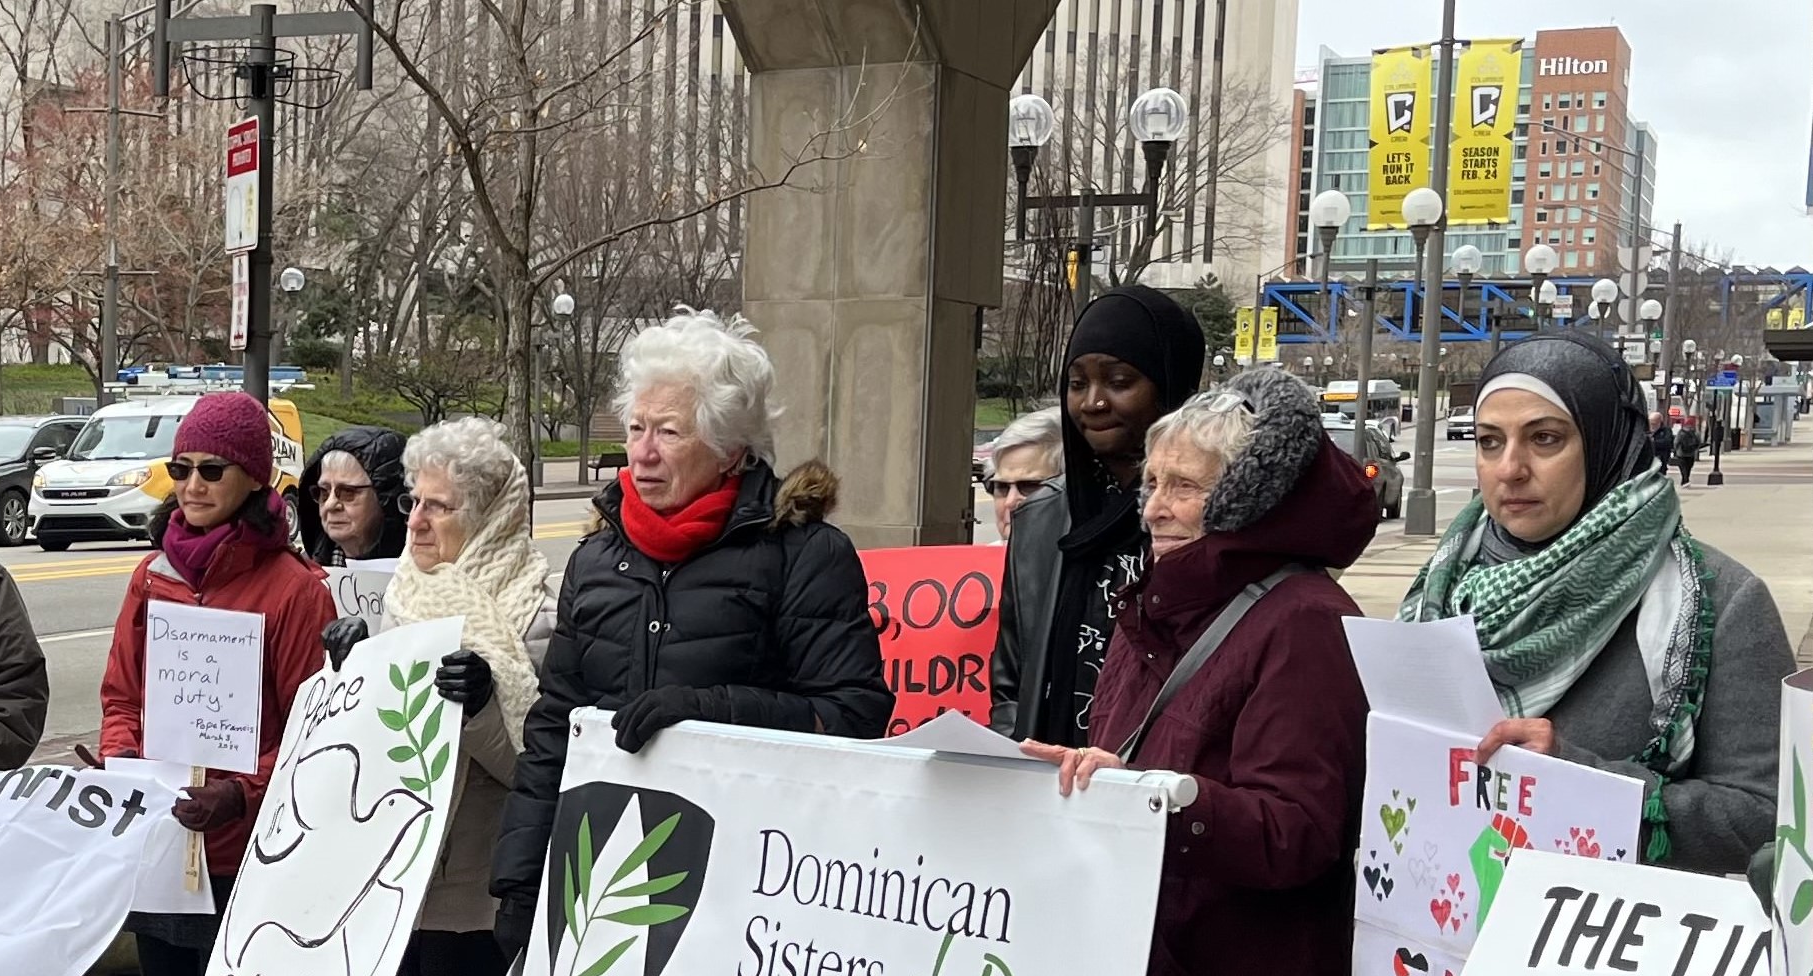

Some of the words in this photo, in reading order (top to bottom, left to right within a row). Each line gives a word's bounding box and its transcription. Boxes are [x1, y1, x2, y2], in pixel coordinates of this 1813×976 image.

[1539, 56, 1608, 76] Hilton
[1386, 152, 1411, 163] LET'S
[1462, 146, 1500, 158] SEASON
[1382, 163, 1403, 175] RUN
[1405, 162, 1415, 174] IT
[1462, 158, 1498, 169] STARTS
[1385, 174, 1412, 186] BACK
[1461, 169, 1481, 180] FEB.
[1484, 168, 1498, 180] 24
[178, 649, 189, 661] is
[205, 655, 217, 664] a
[158, 668, 220, 685] moral
[1449, 747, 1537, 816] FREE
[753, 828, 1012, 943] Dominican
[1527, 886, 1662, 972] THE
